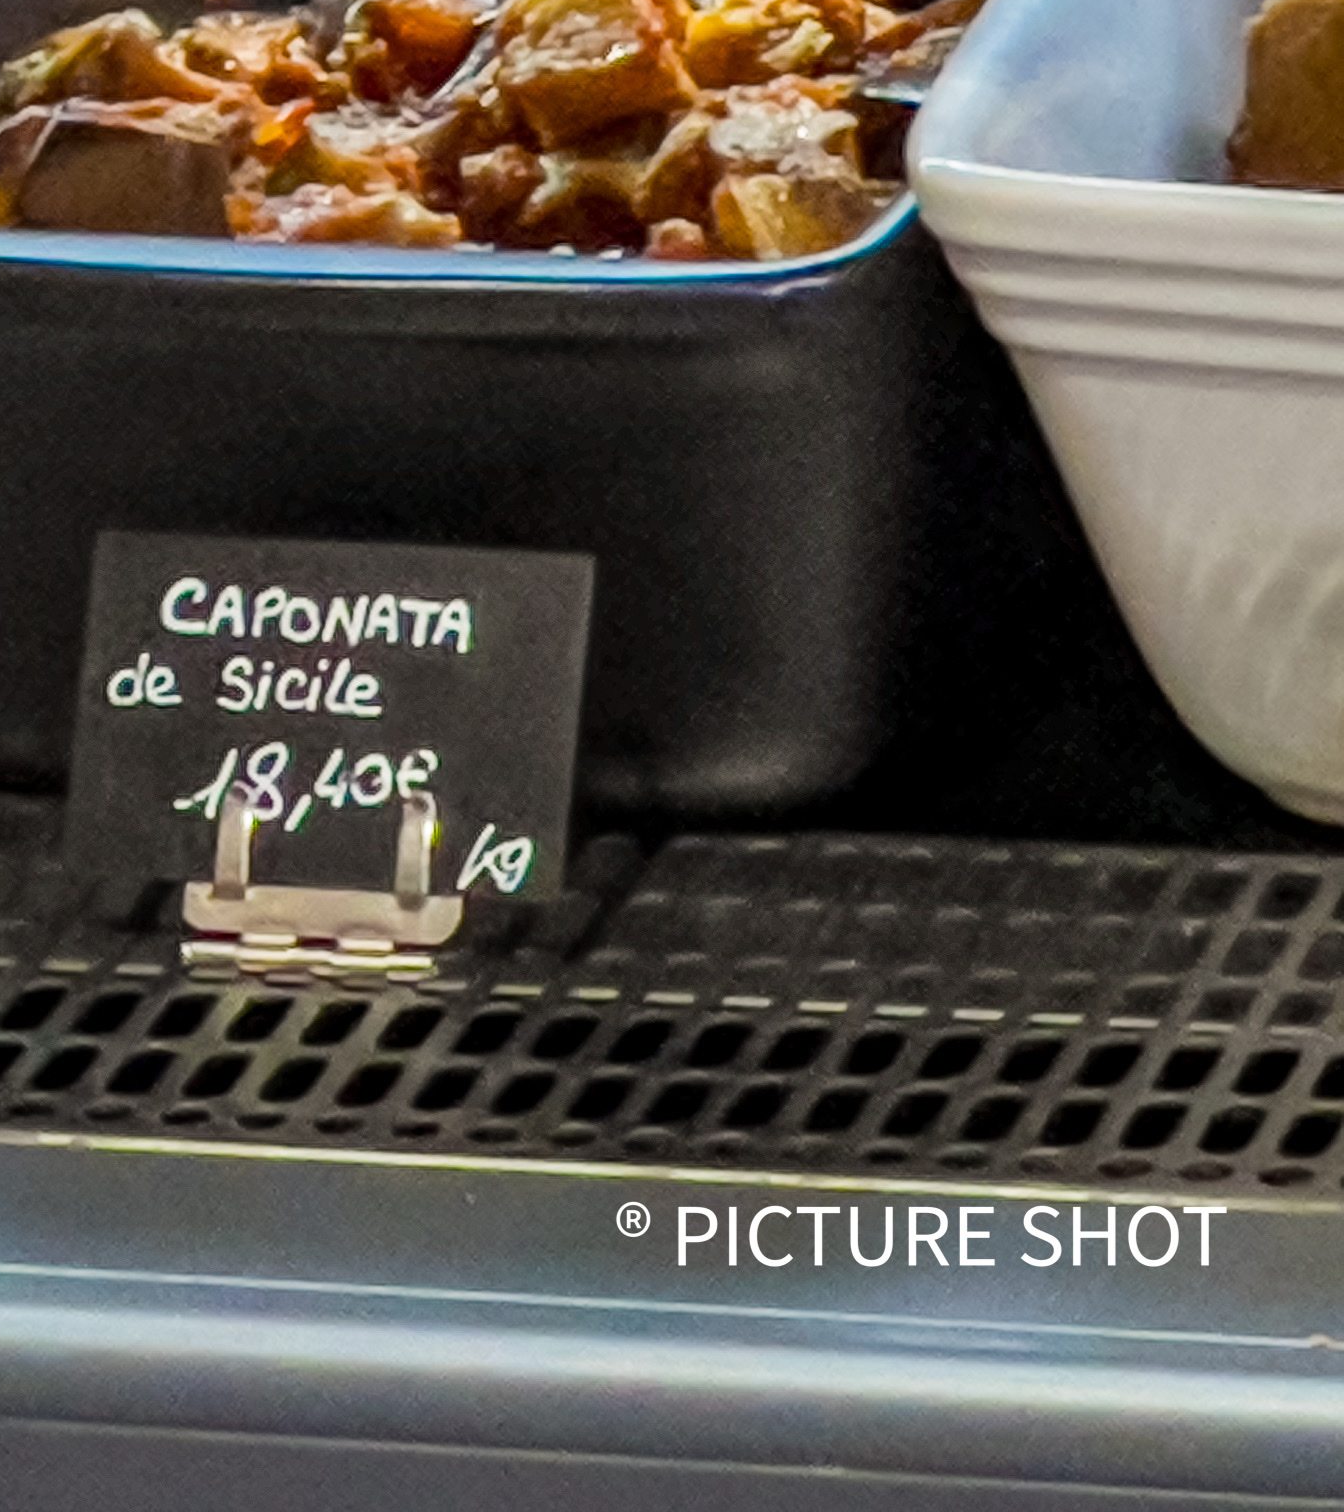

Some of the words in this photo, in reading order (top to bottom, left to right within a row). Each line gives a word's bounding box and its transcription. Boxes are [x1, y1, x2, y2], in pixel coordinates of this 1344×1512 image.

[160, 576, 472, 654] CAPONATA
[107, 652, 183, 708] de
[216, 655, 383, 717] Sicile
